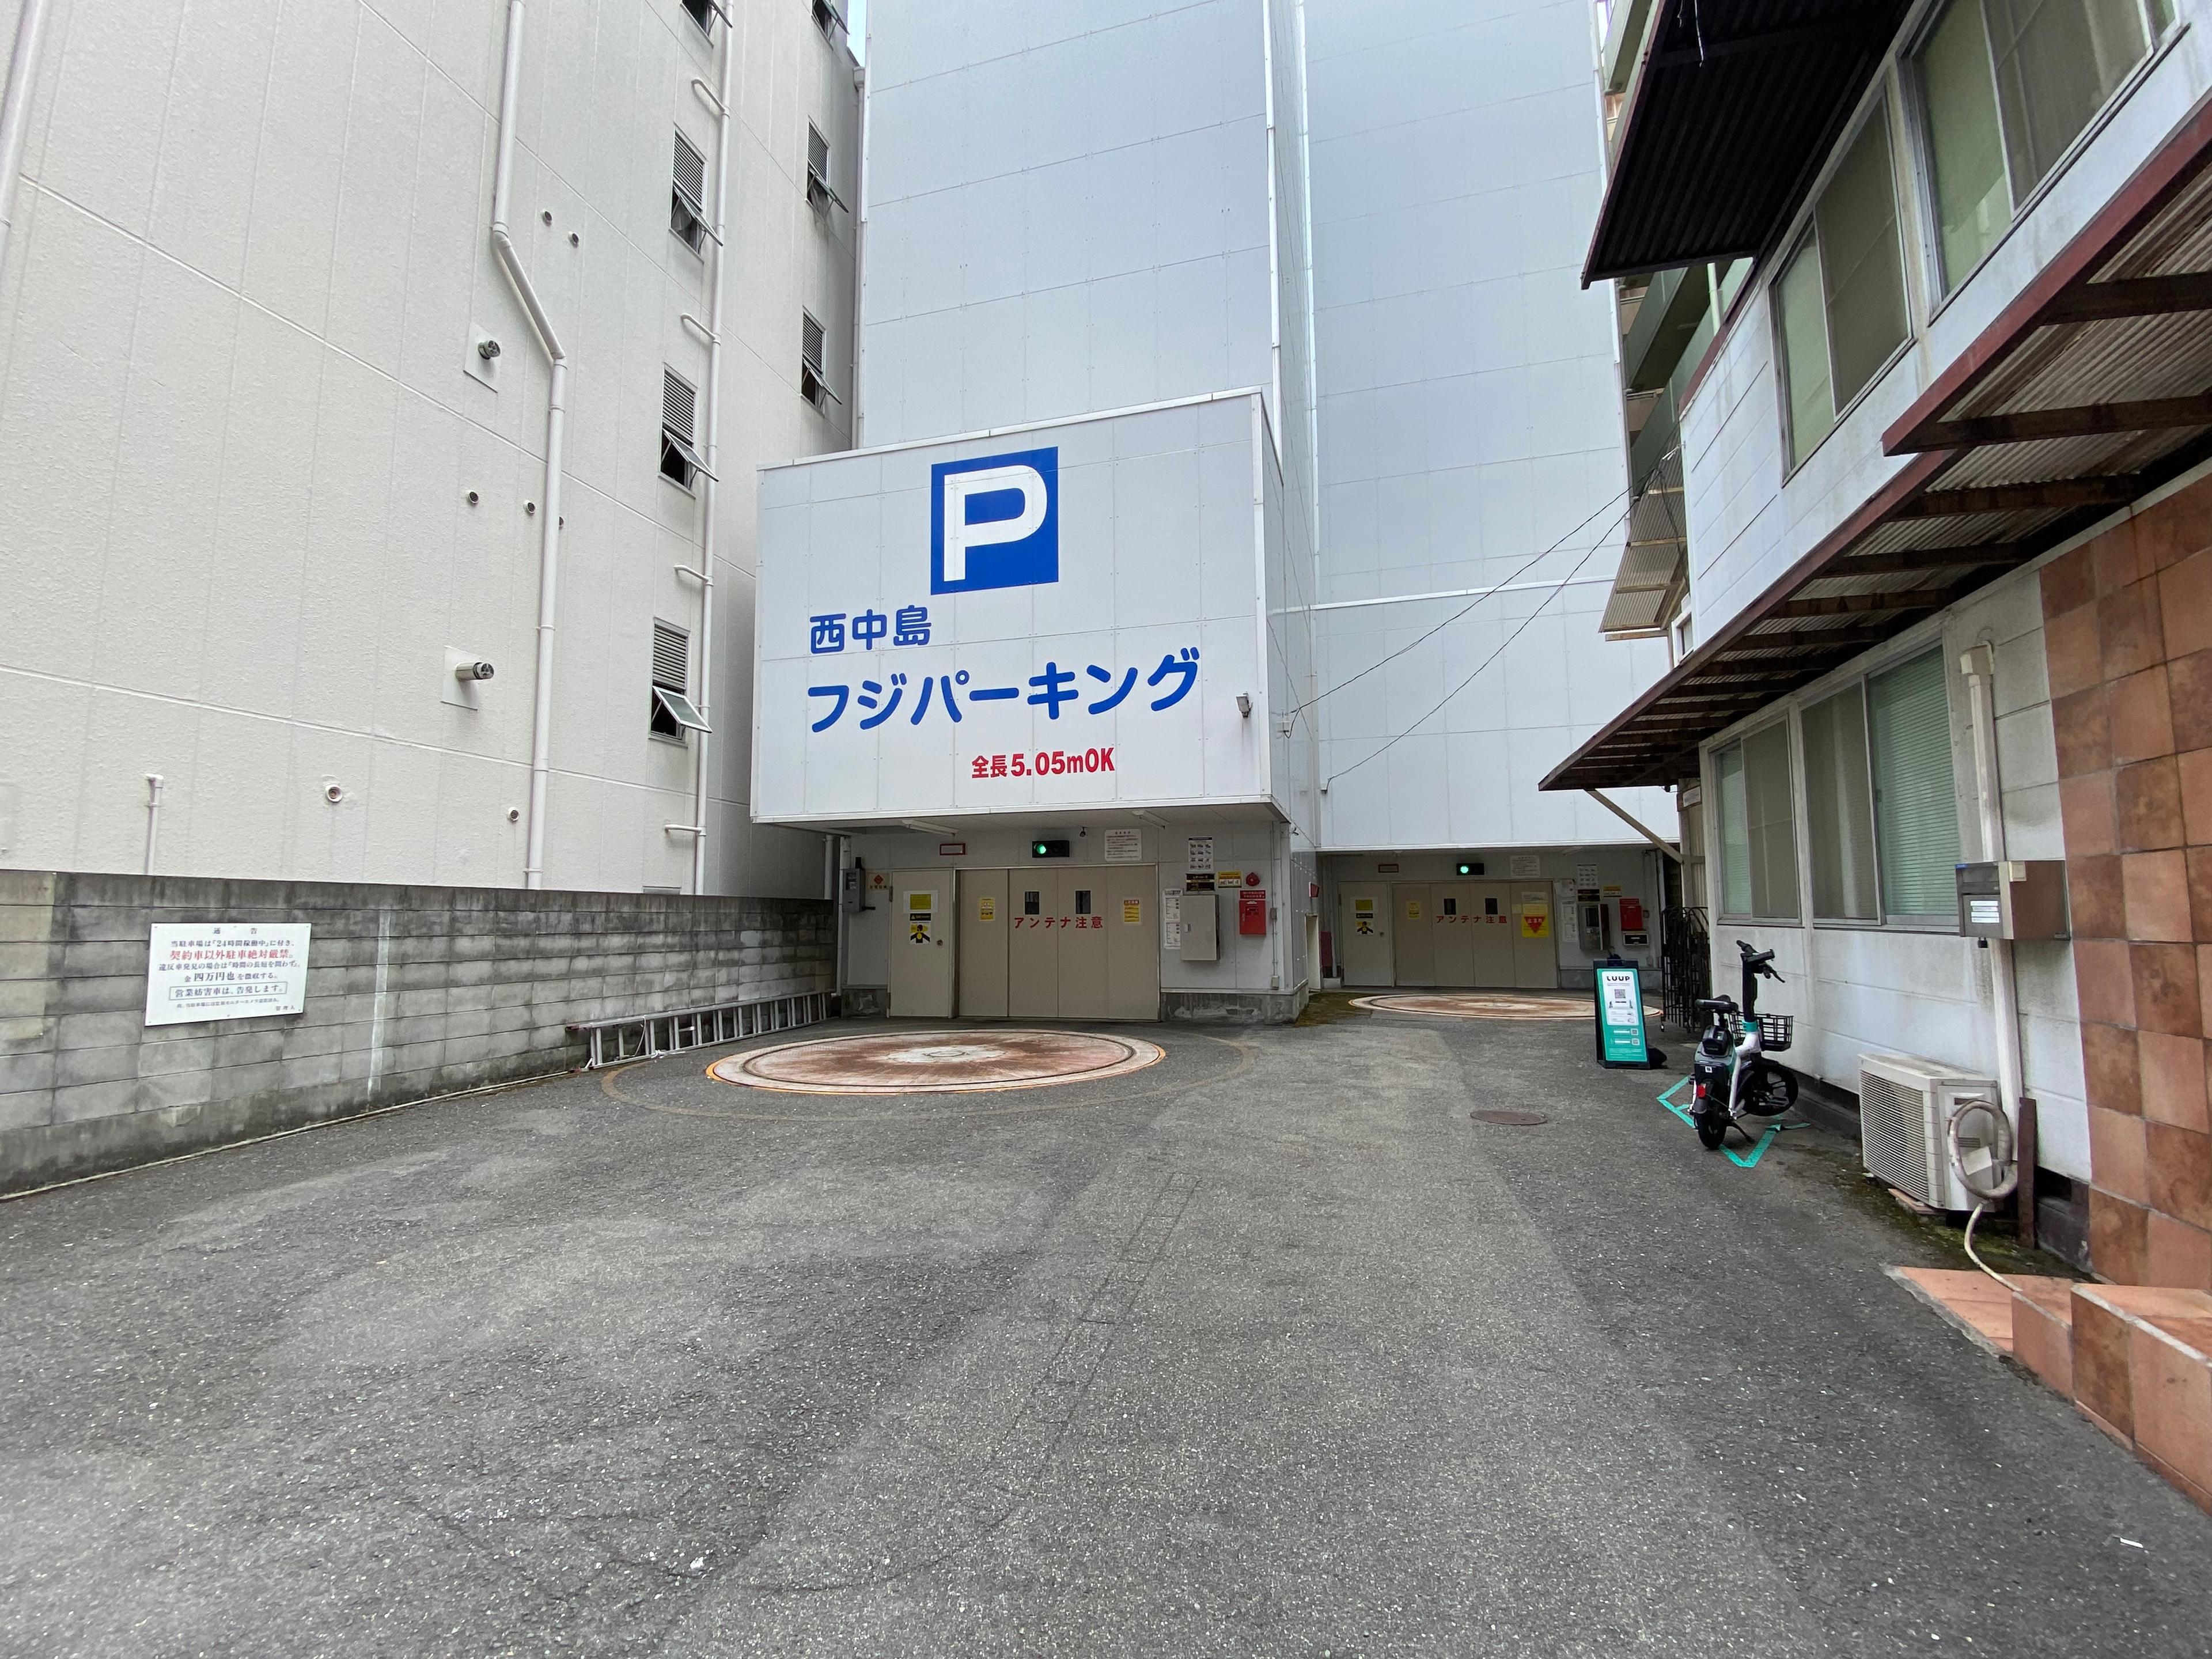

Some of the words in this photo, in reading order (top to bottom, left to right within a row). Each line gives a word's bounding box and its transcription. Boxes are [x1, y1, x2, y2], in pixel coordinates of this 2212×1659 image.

[944, 465, 1047, 582] P
[809, 605, 931, 654] 西中島
[808, 646, 1200, 733] フジパーキング
[972, 747, 1115, 778] 全長5.05mOK
[1014, 916, 1103, 929] アンテナ注意
